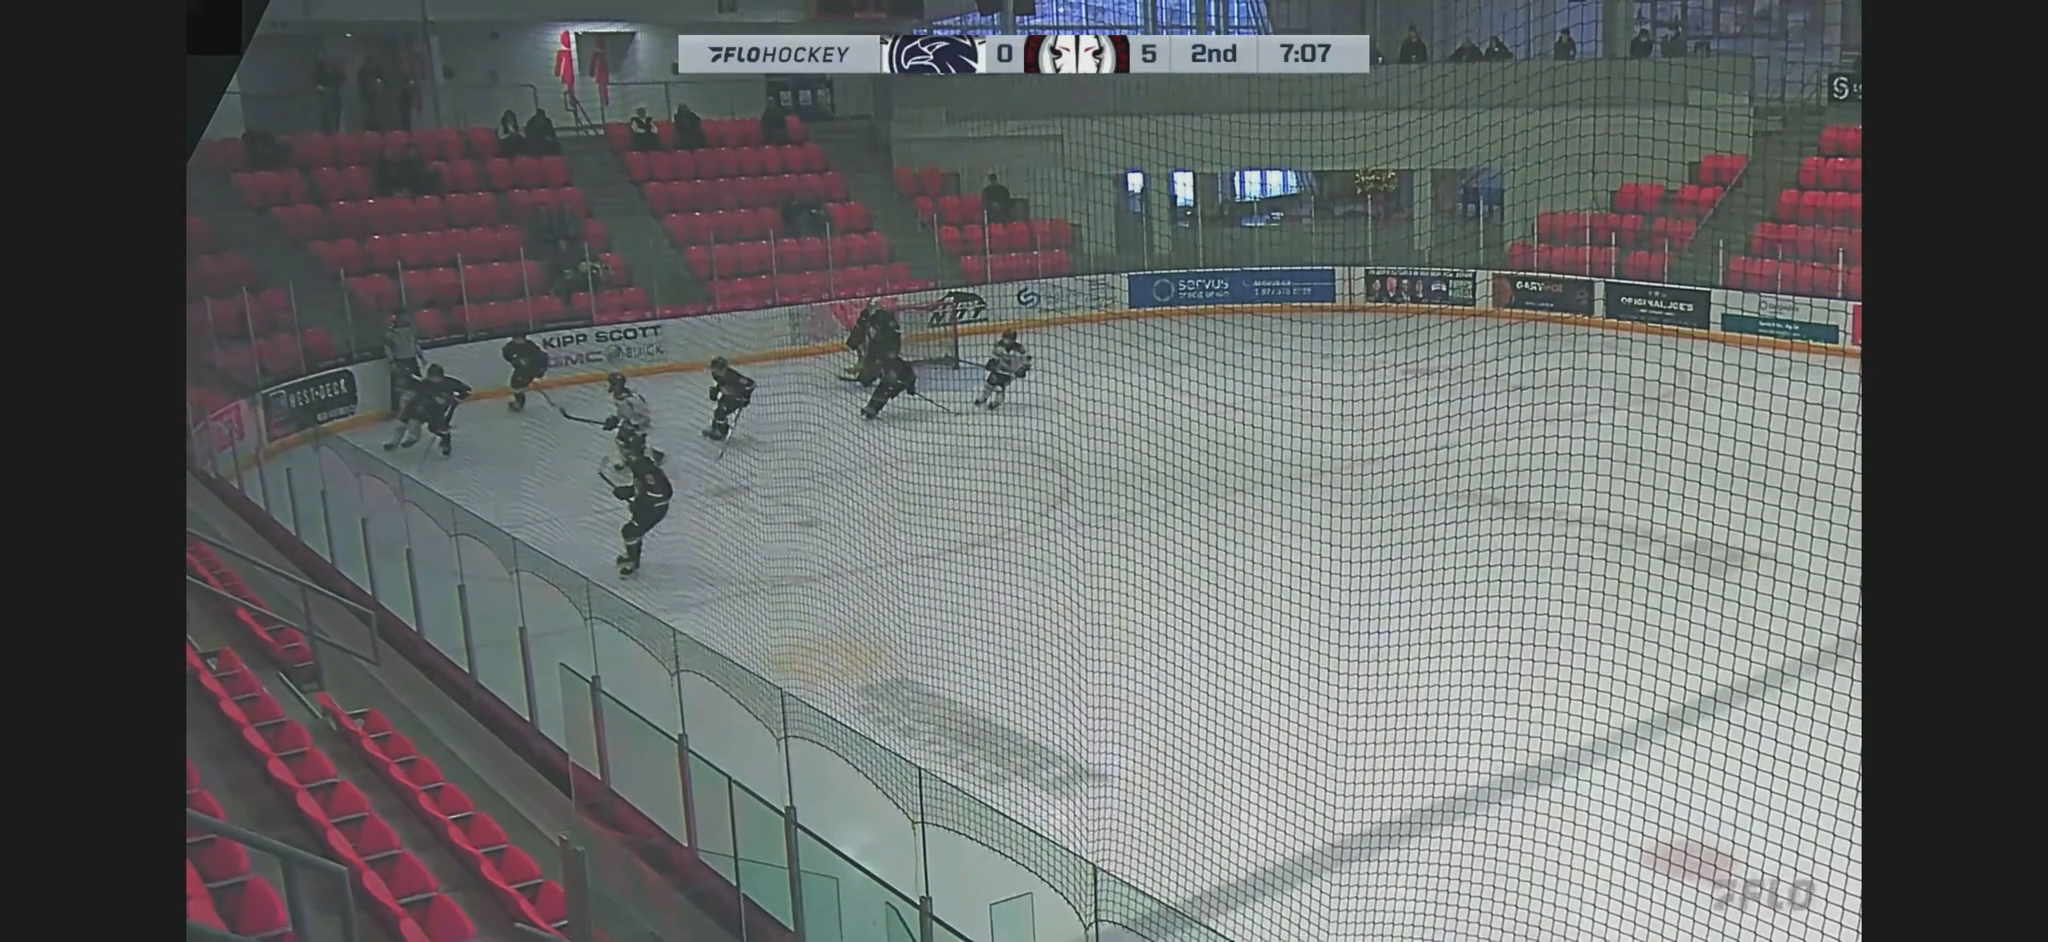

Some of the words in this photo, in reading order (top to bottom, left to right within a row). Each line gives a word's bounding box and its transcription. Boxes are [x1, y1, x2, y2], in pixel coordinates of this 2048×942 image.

[541, 333, 588, 350] KIPP
[594, 325, 662, 343] SCOTT
[625, 344, 664, 358] BUICK
